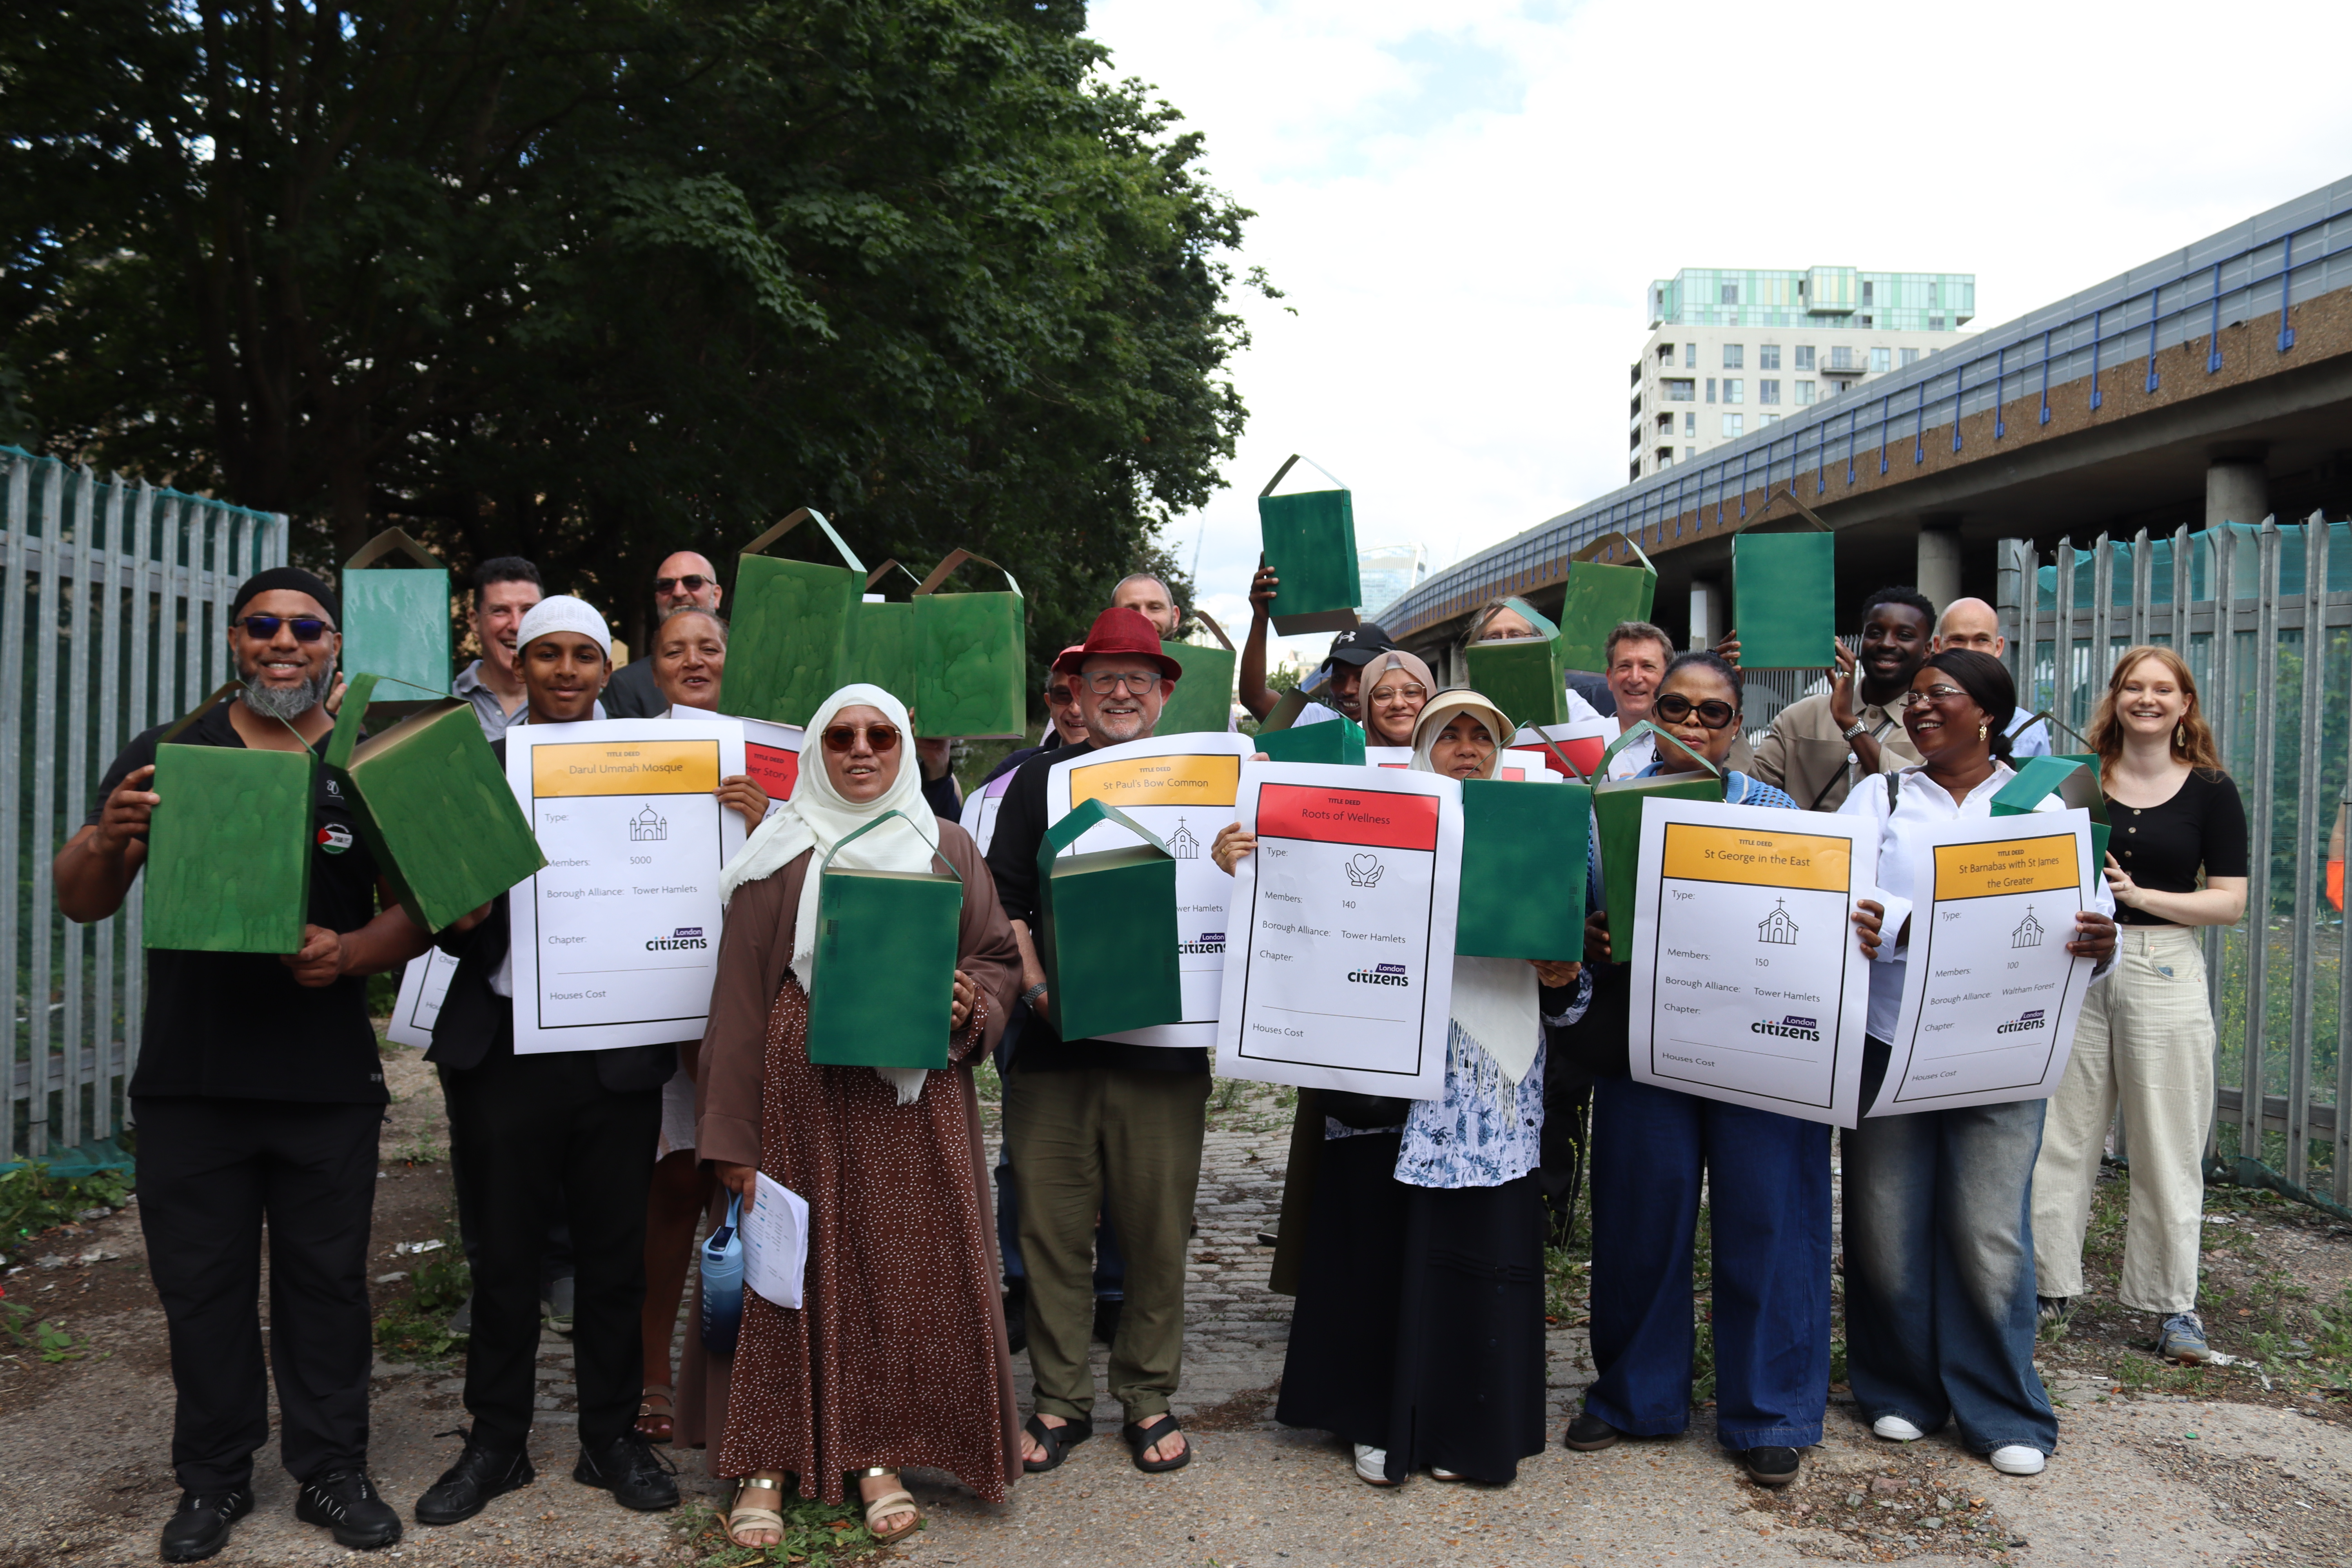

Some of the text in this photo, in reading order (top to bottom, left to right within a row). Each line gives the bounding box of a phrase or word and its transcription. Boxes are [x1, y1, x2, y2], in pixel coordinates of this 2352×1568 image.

[570, 764, 683, 774] Darul Ummah Mosque
[764, 768, 788, 781] Story
[1116, 779, 1141, 788] Paul's
[544, 814, 568, 823] Type:
[1302, 809, 1390, 824] Roots of Wellness
[1093, 821, 1105, 829] pe:
[1267, 847, 1287, 857] Type:
[1705, 849, 1715, 858] St
[1718, 851, 1755, 864] George
[1770, 855, 1787, 864] the
[1790, 857, 1810, 866] East
[630, 856, 652, 864] 5000
[1960, 858, 2059, 873] St Barnabas with St James
[1987, 877, 2034, 888] the Greater
[547, 889, 585, 899] Borough
[662, 885, 697, 893] Hamlets
[1265, 891, 1302, 903] Members:
[1672, 890, 1695, 900] Type:
[1193, 904, 1223, 912] Hamlets
[1942, 912, 1961, 921] Type:
[1263, 921, 1405, 943] Borough Alliance: Tower Hamlets
[548, 936, 586, 945] Chapter:
[646, 937, 707, 951] citizens
[1260, 950, 1293, 962] Chapter:
[1668, 948, 1710, 960] Members:
[1379, 964, 1405, 973] London
[1935, 968, 1971, 977] Members:
[1347, 968, 1408, 987] citizens
[1666, 976, 1820, 1002] Borough Alliance: Tower Hamlets
[1931, 995, 1961, 1005] Borough
[1963, 993, 1992, 1001] Alliance:
[2003, 987, 2032, 995] Waltham
[1664, 1004, 1700, 1014] Chapter:
[1786, 1017, 1815, 1027] London
[1925, 1023, 1955, 1032] Chapter:
[1997, 1019, 2045, 1034] citizens
[1253, 1023, 1303, 1037] Houses Cost
[1751, 1019, 1820, 1042] citizens
[1663, 1053, 1715, 1067] Houses Cost
